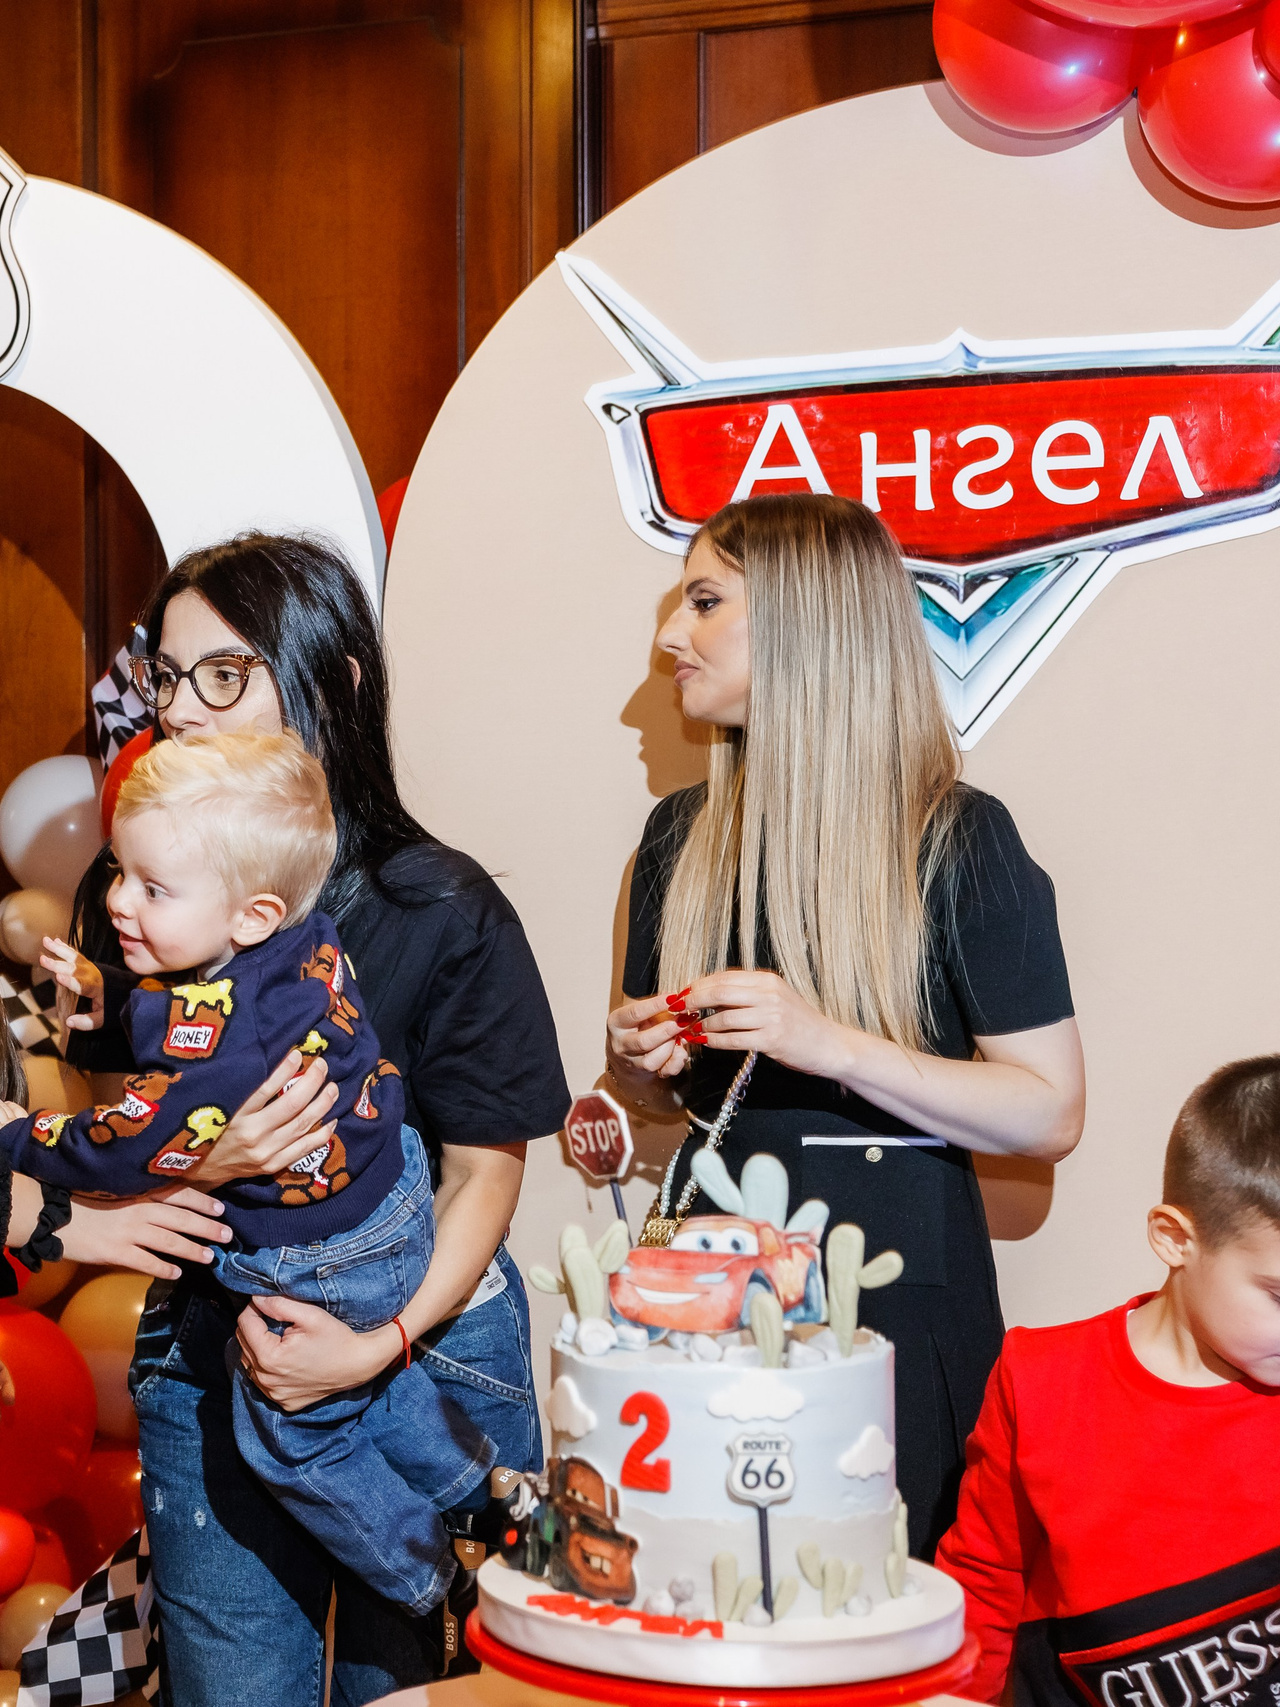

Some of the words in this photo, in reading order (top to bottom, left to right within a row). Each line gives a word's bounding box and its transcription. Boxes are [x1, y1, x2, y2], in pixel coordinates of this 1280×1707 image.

[169, 1029, 211, 1046] HONEY
[570, 1117, 620, 1156] STOP
[619, 1390, 671, 1494] 2
[742, 1439, 782, 1451] ROUTE
[498, 1469, 518, 1484] BO
[741, 1457, 786, 1490] 66
[465, 1540, 476, 1554] BO
[445, 1622, 455, 1651] BOSS
